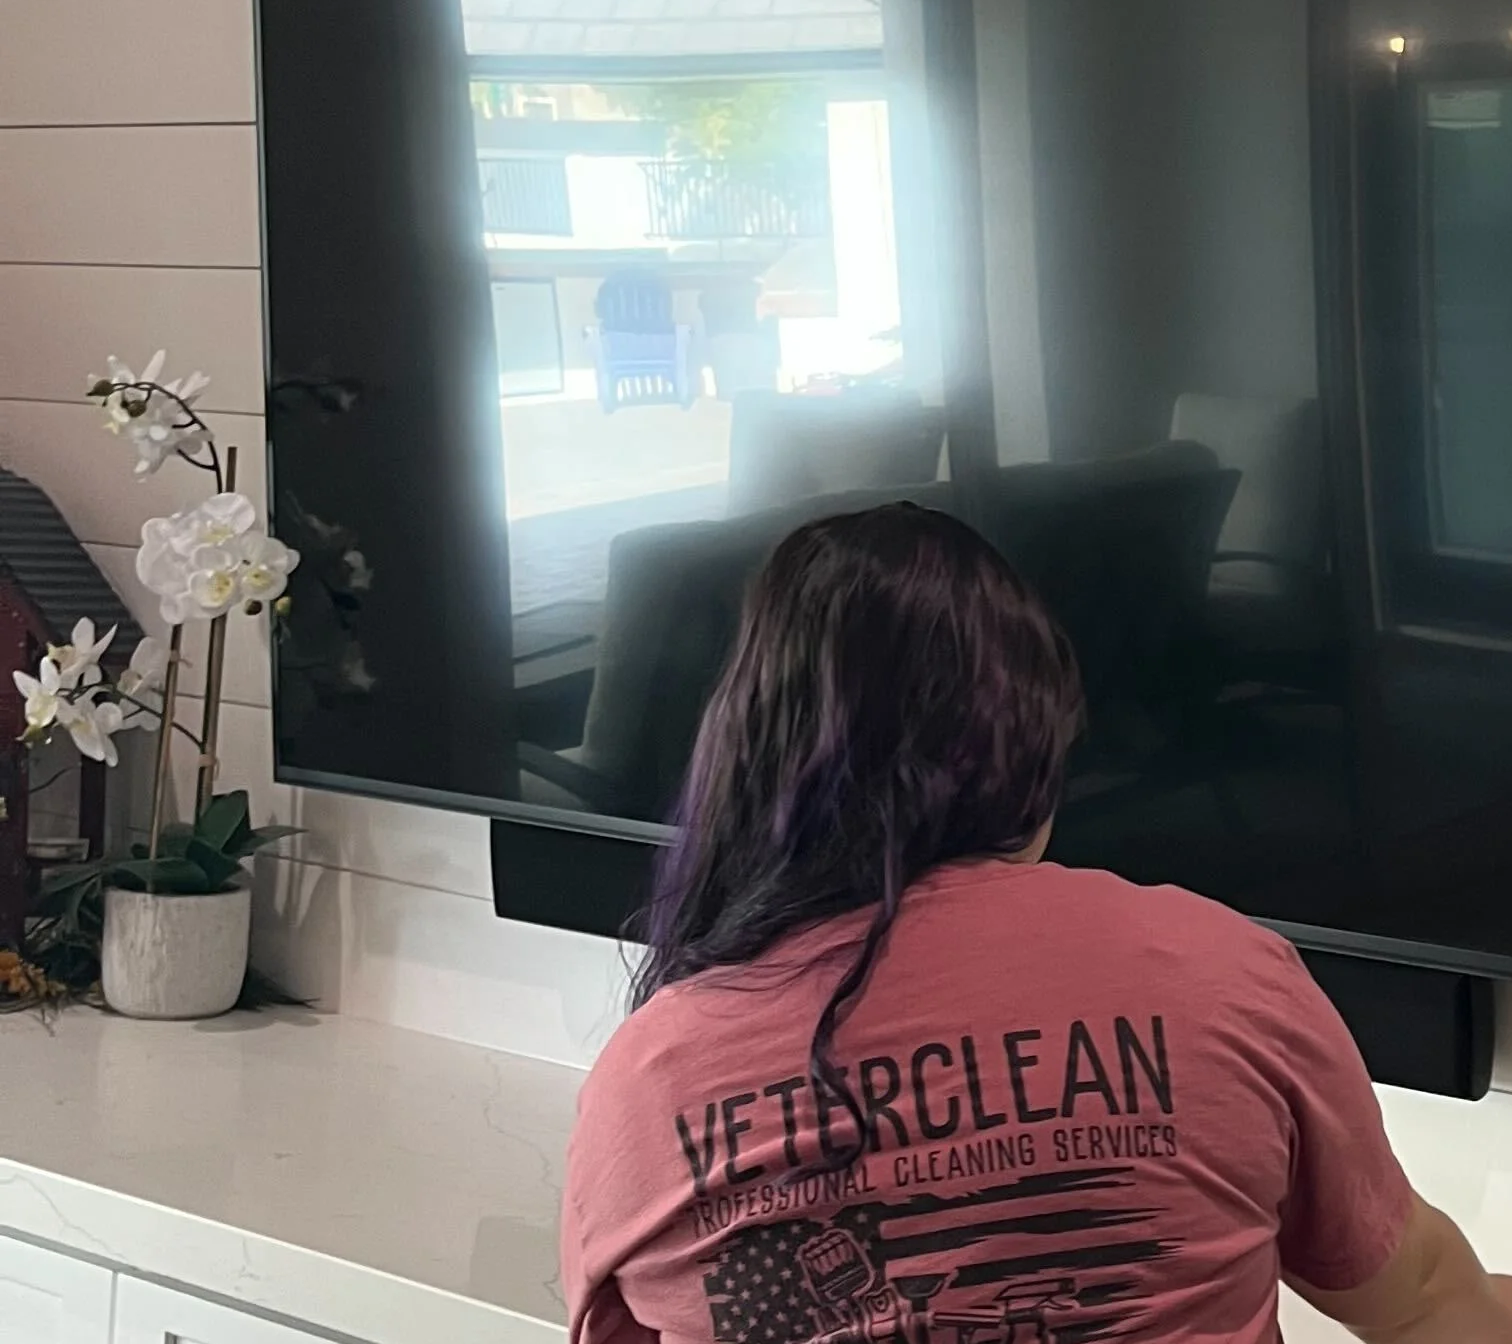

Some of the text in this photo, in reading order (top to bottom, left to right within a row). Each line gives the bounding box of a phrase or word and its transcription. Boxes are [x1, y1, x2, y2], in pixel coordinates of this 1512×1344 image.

[676, 1015, 1174, 1196] VETERCLEAN
[894, 1133, 1035, 1187] CLEANING
[1053, 1125, 1177, 1161] SERVICES
